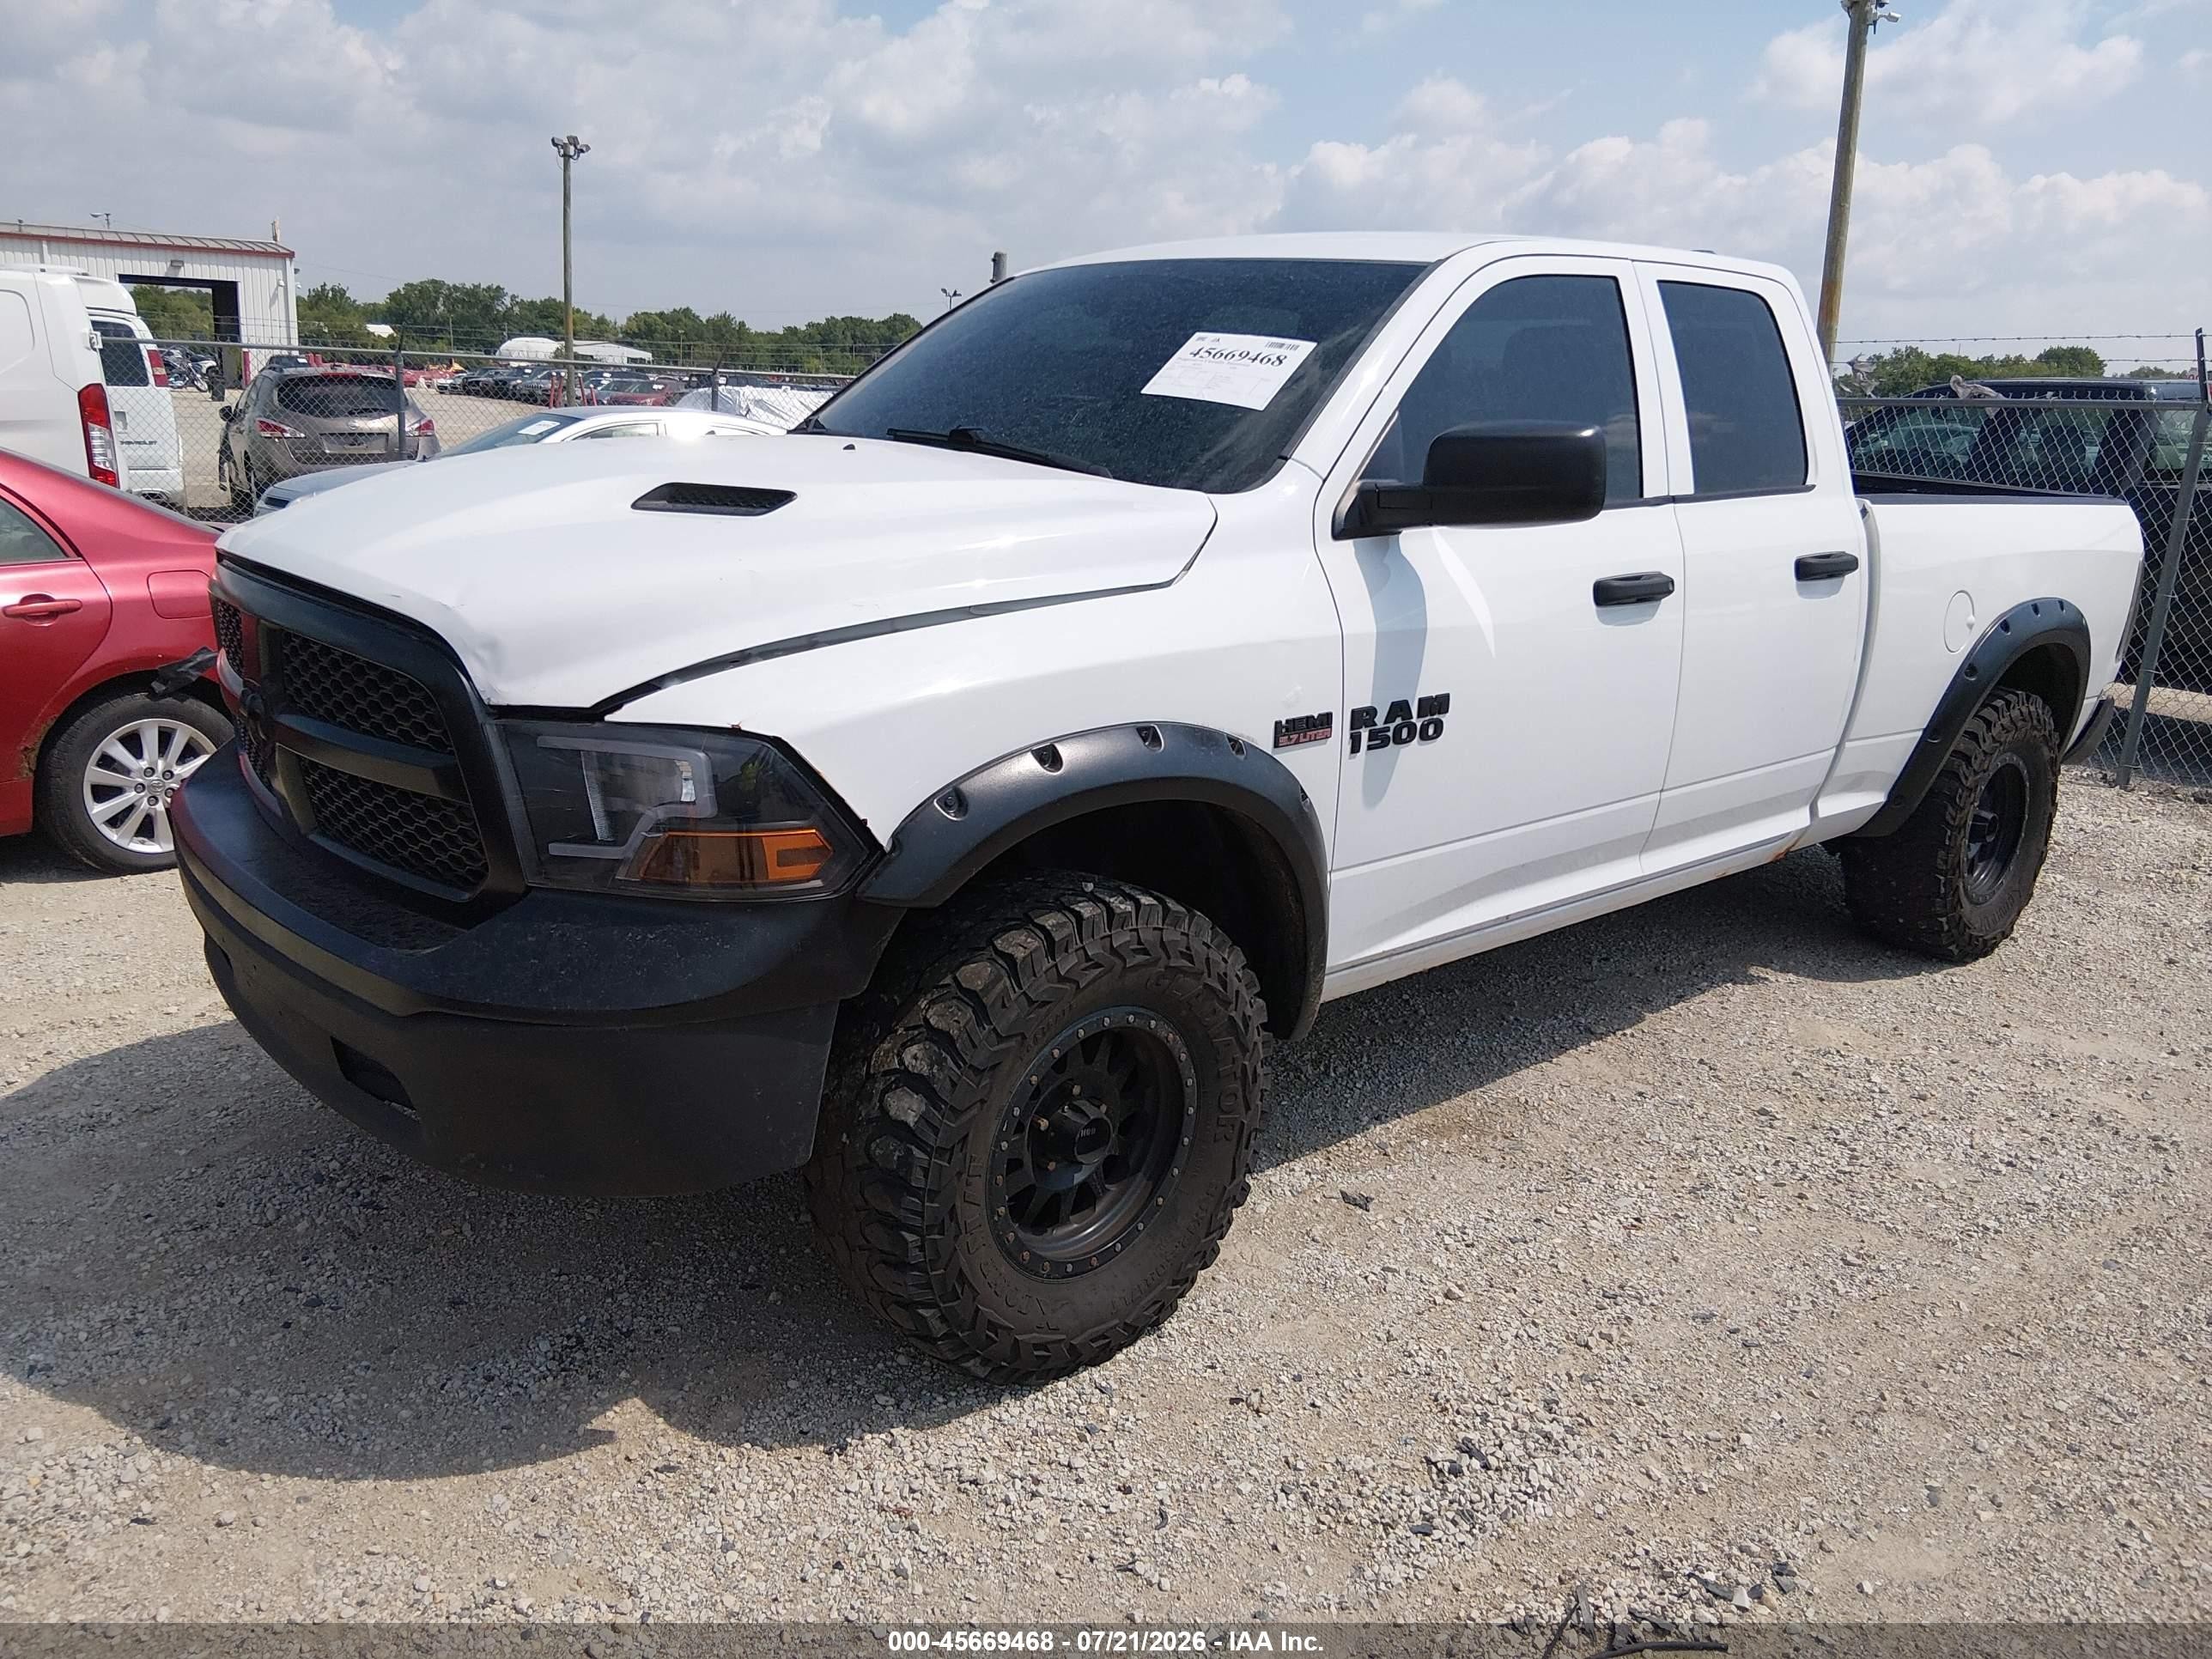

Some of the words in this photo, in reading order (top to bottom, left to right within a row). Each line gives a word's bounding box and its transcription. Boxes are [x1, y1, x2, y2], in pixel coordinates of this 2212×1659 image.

[1188, 345, 1288, 368] 45669468
[1274, 711, 1334, 734] HEMI
[1350, 692, 1450, 731] RAM
[1279, 733, 1297, 747] 5.7
[1298, 728, 1332, 744] LITER
[1348, 718, 1444, 755] 1500
